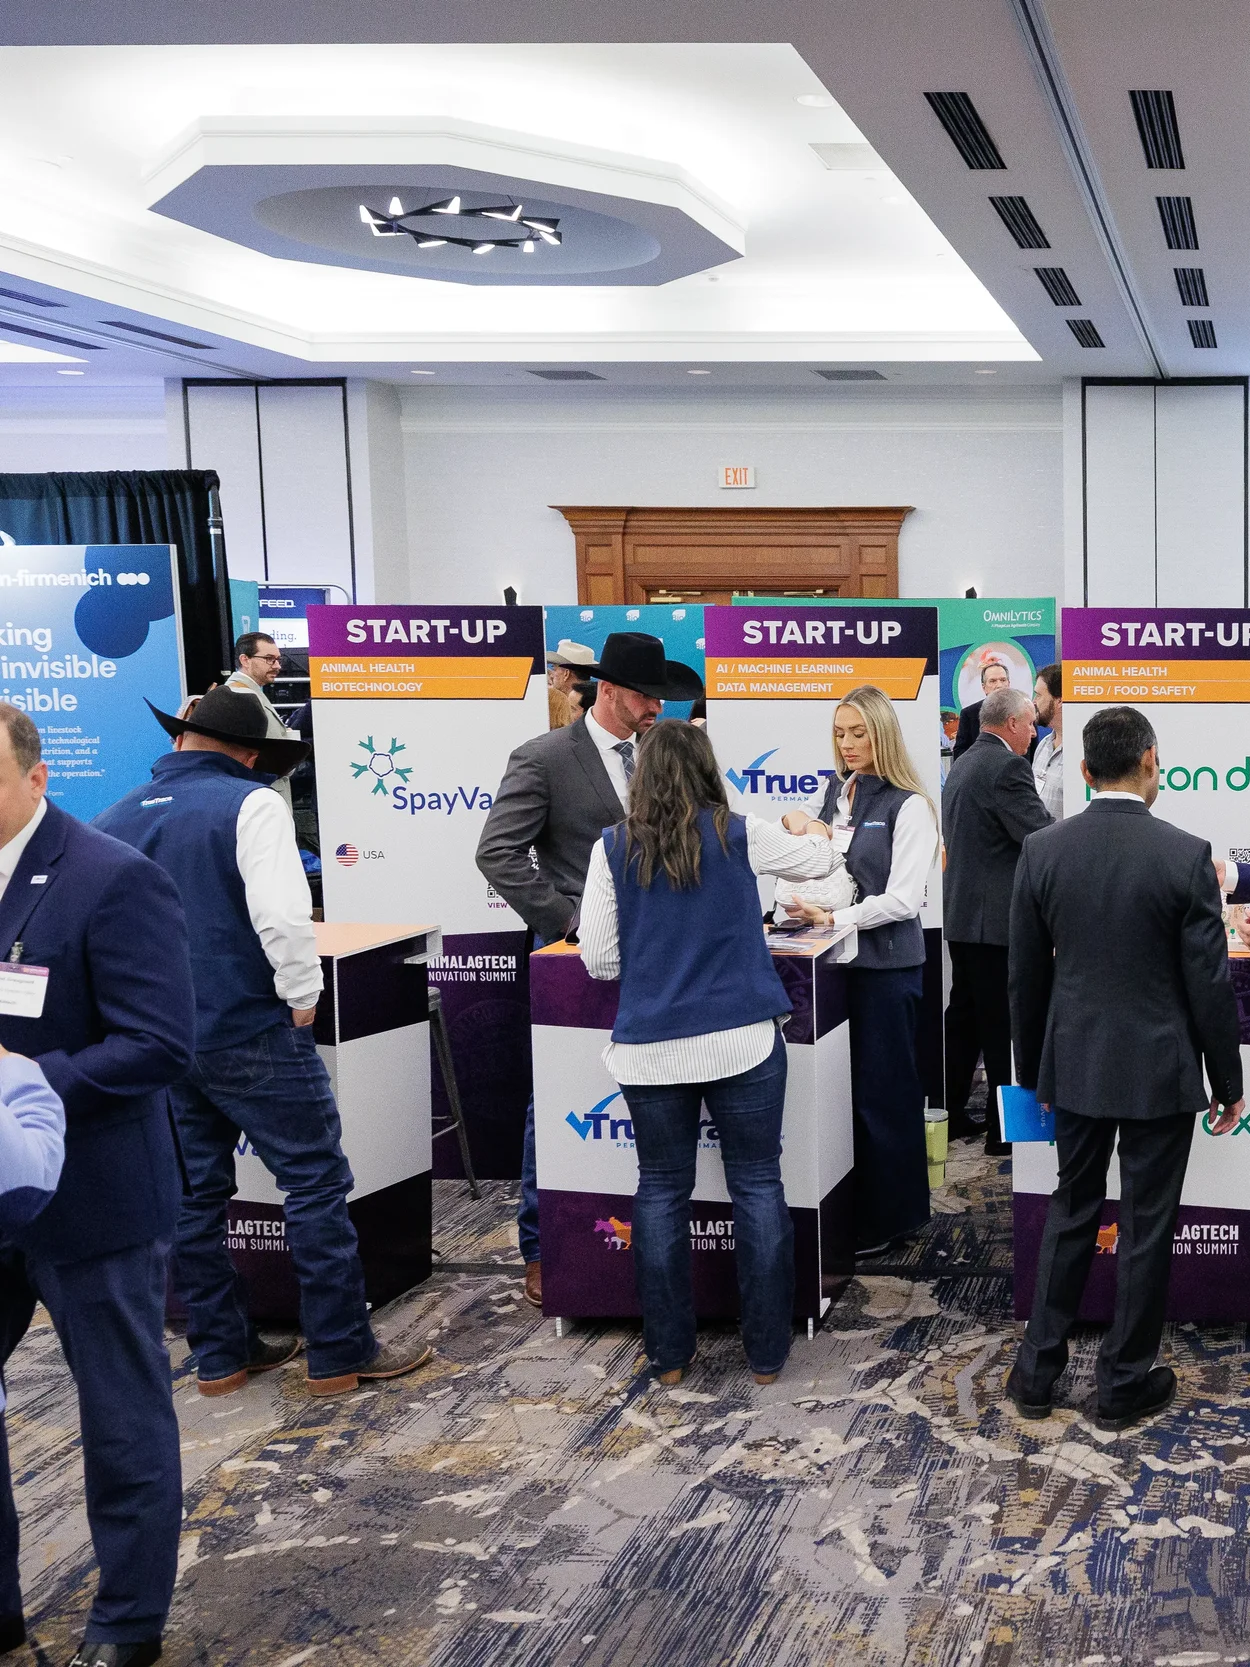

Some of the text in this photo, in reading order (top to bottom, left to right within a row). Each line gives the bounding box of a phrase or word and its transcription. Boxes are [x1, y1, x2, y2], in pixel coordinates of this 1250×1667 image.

[724, 467, 749, 486] EXIT
[346, 618, 507, 644] START-UP
[743, 620, 902, 645] START-UP
[1, 655, 117, 680] invisible
[321, 663, 415, 673] ANIMAL HEALTH
[716, 664, 854, 674] AI / MACHINE LEARNING
[1073, 666, 1168, 677] ANIMAL HEALTH
[321, 681, 423, 692] BIOTECHNOLOGY
[716, 682, 833, 693] DATA MANAGEMENT
[1073, 685, 1197, 696] FEED / FOOD SAFETY
[57, 759, 93, 767] supports
[362, 850, 385, 860] USA
[480, 971, 517, 982] SUMMIT
[250, 1238, 289, 1251] SUMMI
[1196, 1243, 1239, 1255] SUMMIT
